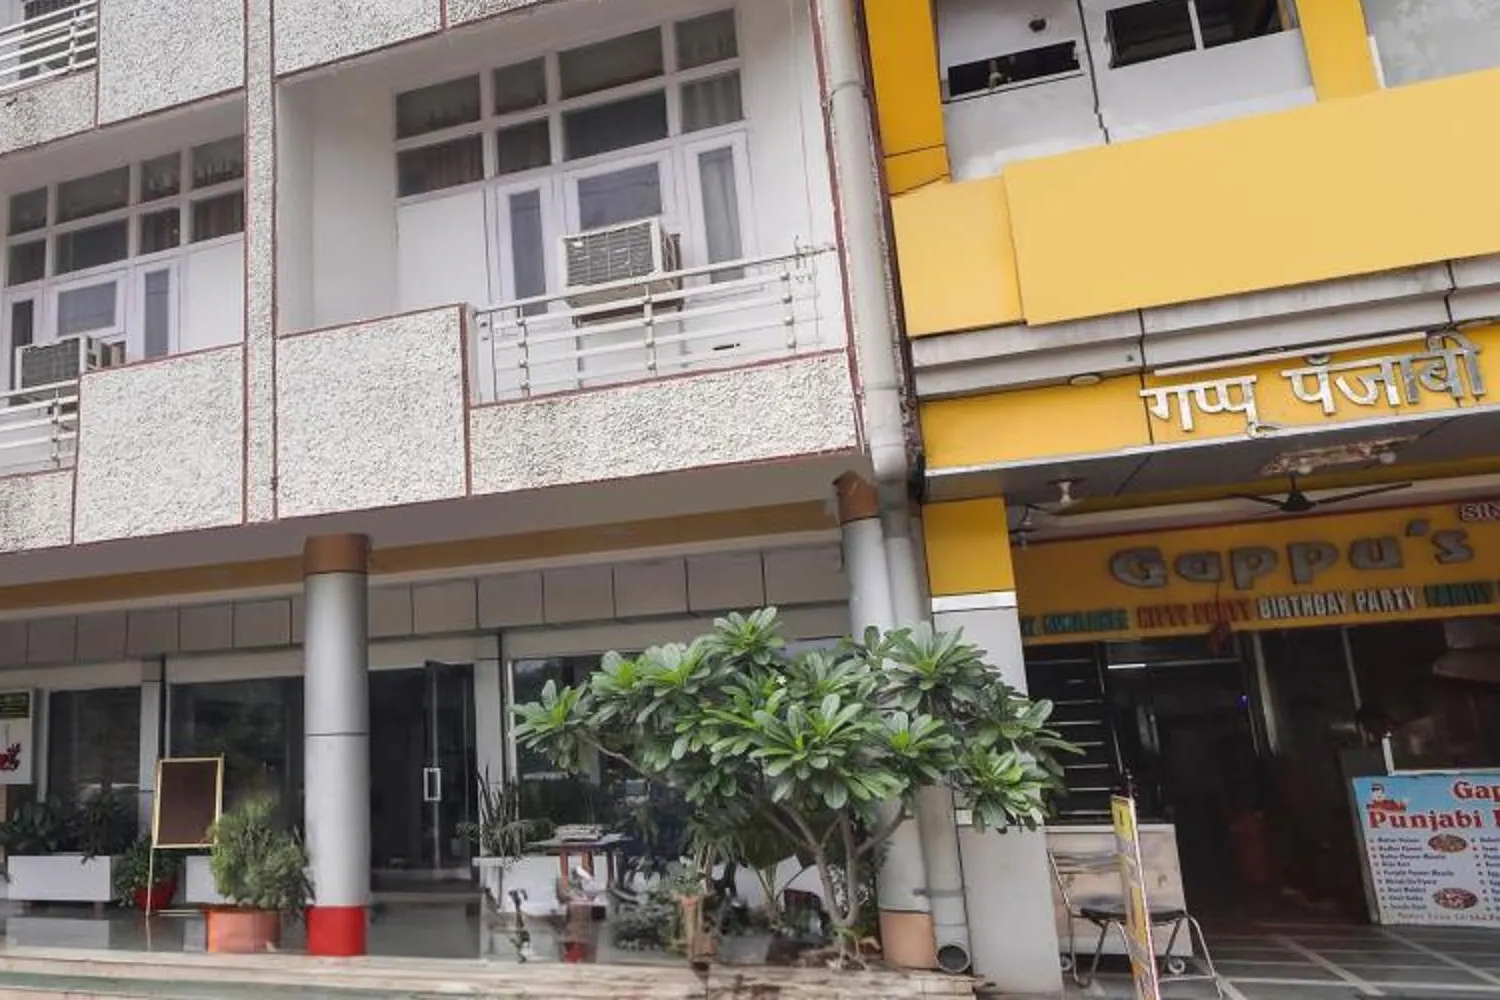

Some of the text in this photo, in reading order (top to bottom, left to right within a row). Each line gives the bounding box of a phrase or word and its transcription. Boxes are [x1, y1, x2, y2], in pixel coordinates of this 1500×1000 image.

[1257, 590, 1348, 620] BIRTHDAY
[1353, 586, 1416, 613] PARTY
[1368, 809, 1484, 832] Punjabi
